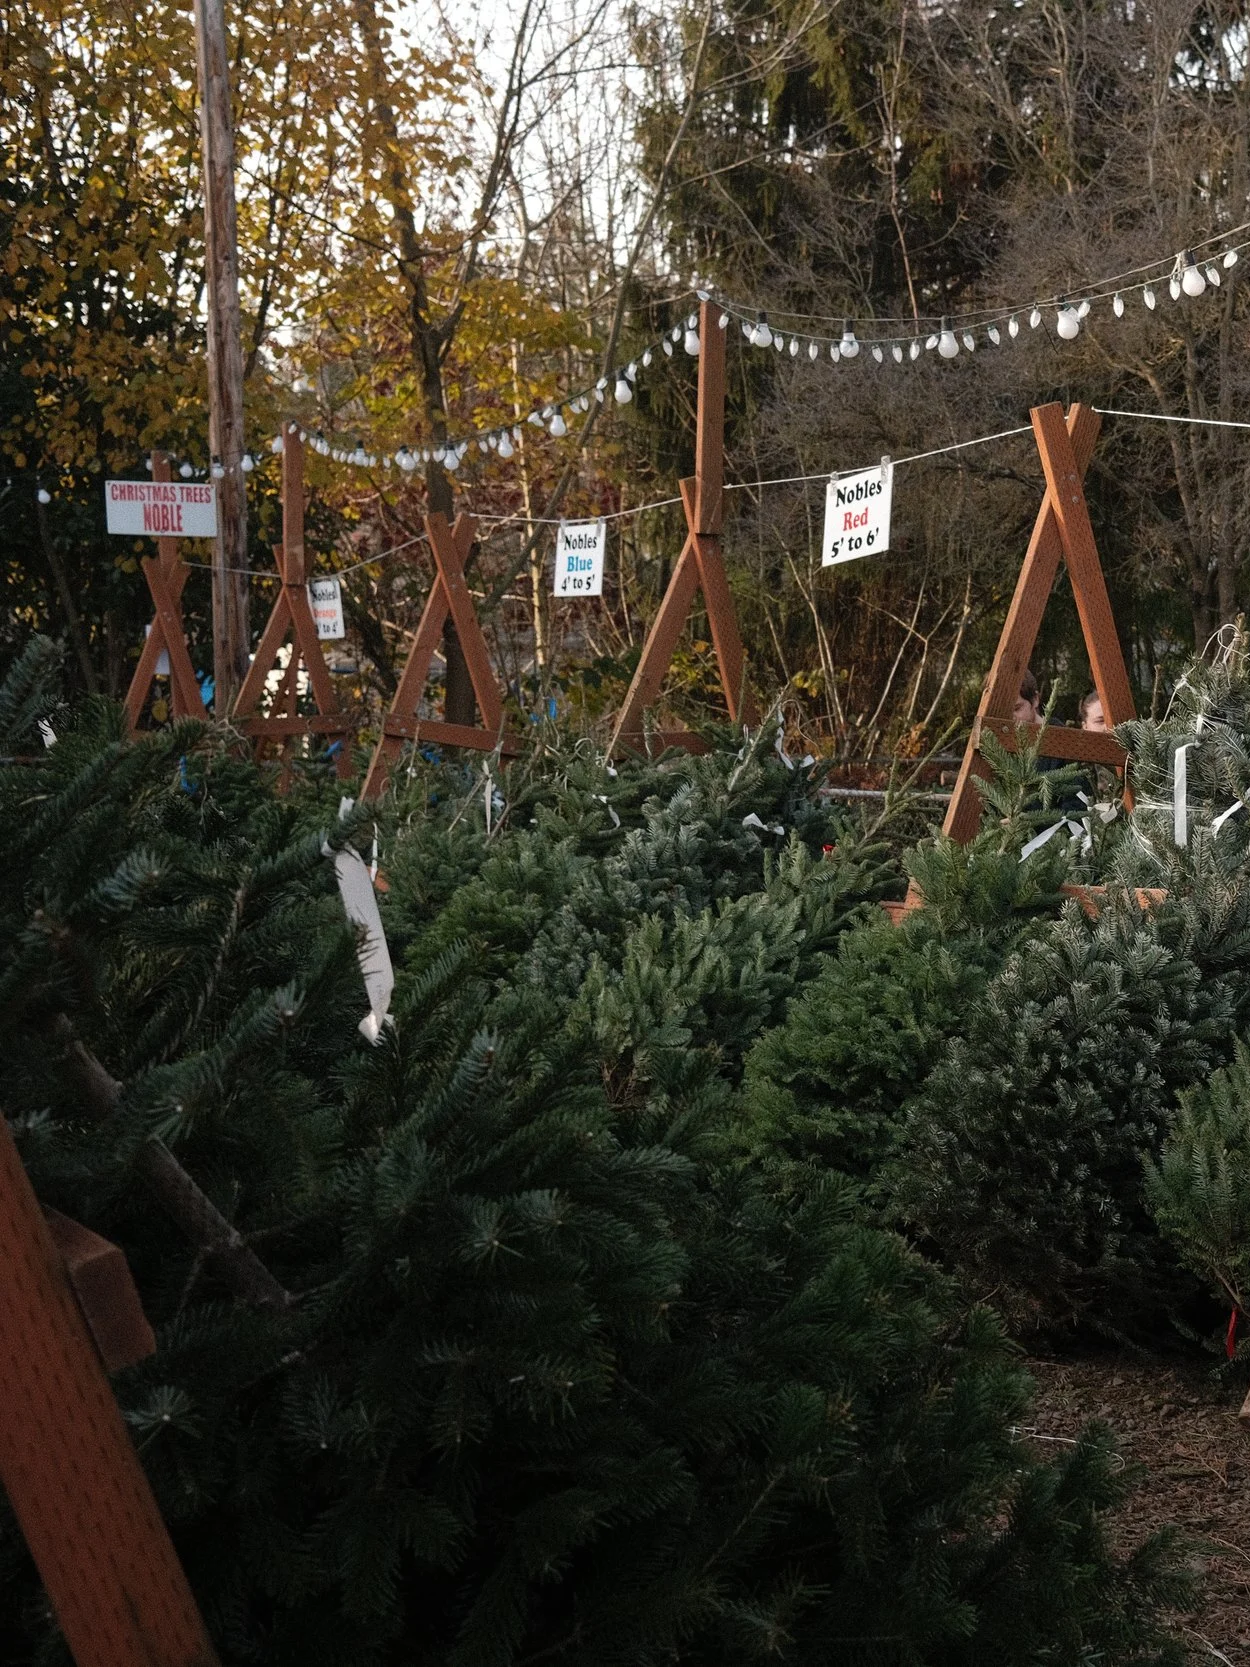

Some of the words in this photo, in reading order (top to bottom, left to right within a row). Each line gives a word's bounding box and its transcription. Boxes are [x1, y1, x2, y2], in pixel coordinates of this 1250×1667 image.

[111, 484, 177, 502] CHRISTMAS
[180, 486, 212, 504] TREES
[836, 480, 883, 508] Nobles
[143, 503, 184, 532] NOBLE
[843, 507, 868, 532] Red
[564, 533, 598, 551] Nobles
[831, 537, 844, 558] 5'
[848, 536, 862, 552] to
[866, 527, 879, 546] 6'
[567, 555, 593, 572] Blue
[573, 577, 583, 589] to
